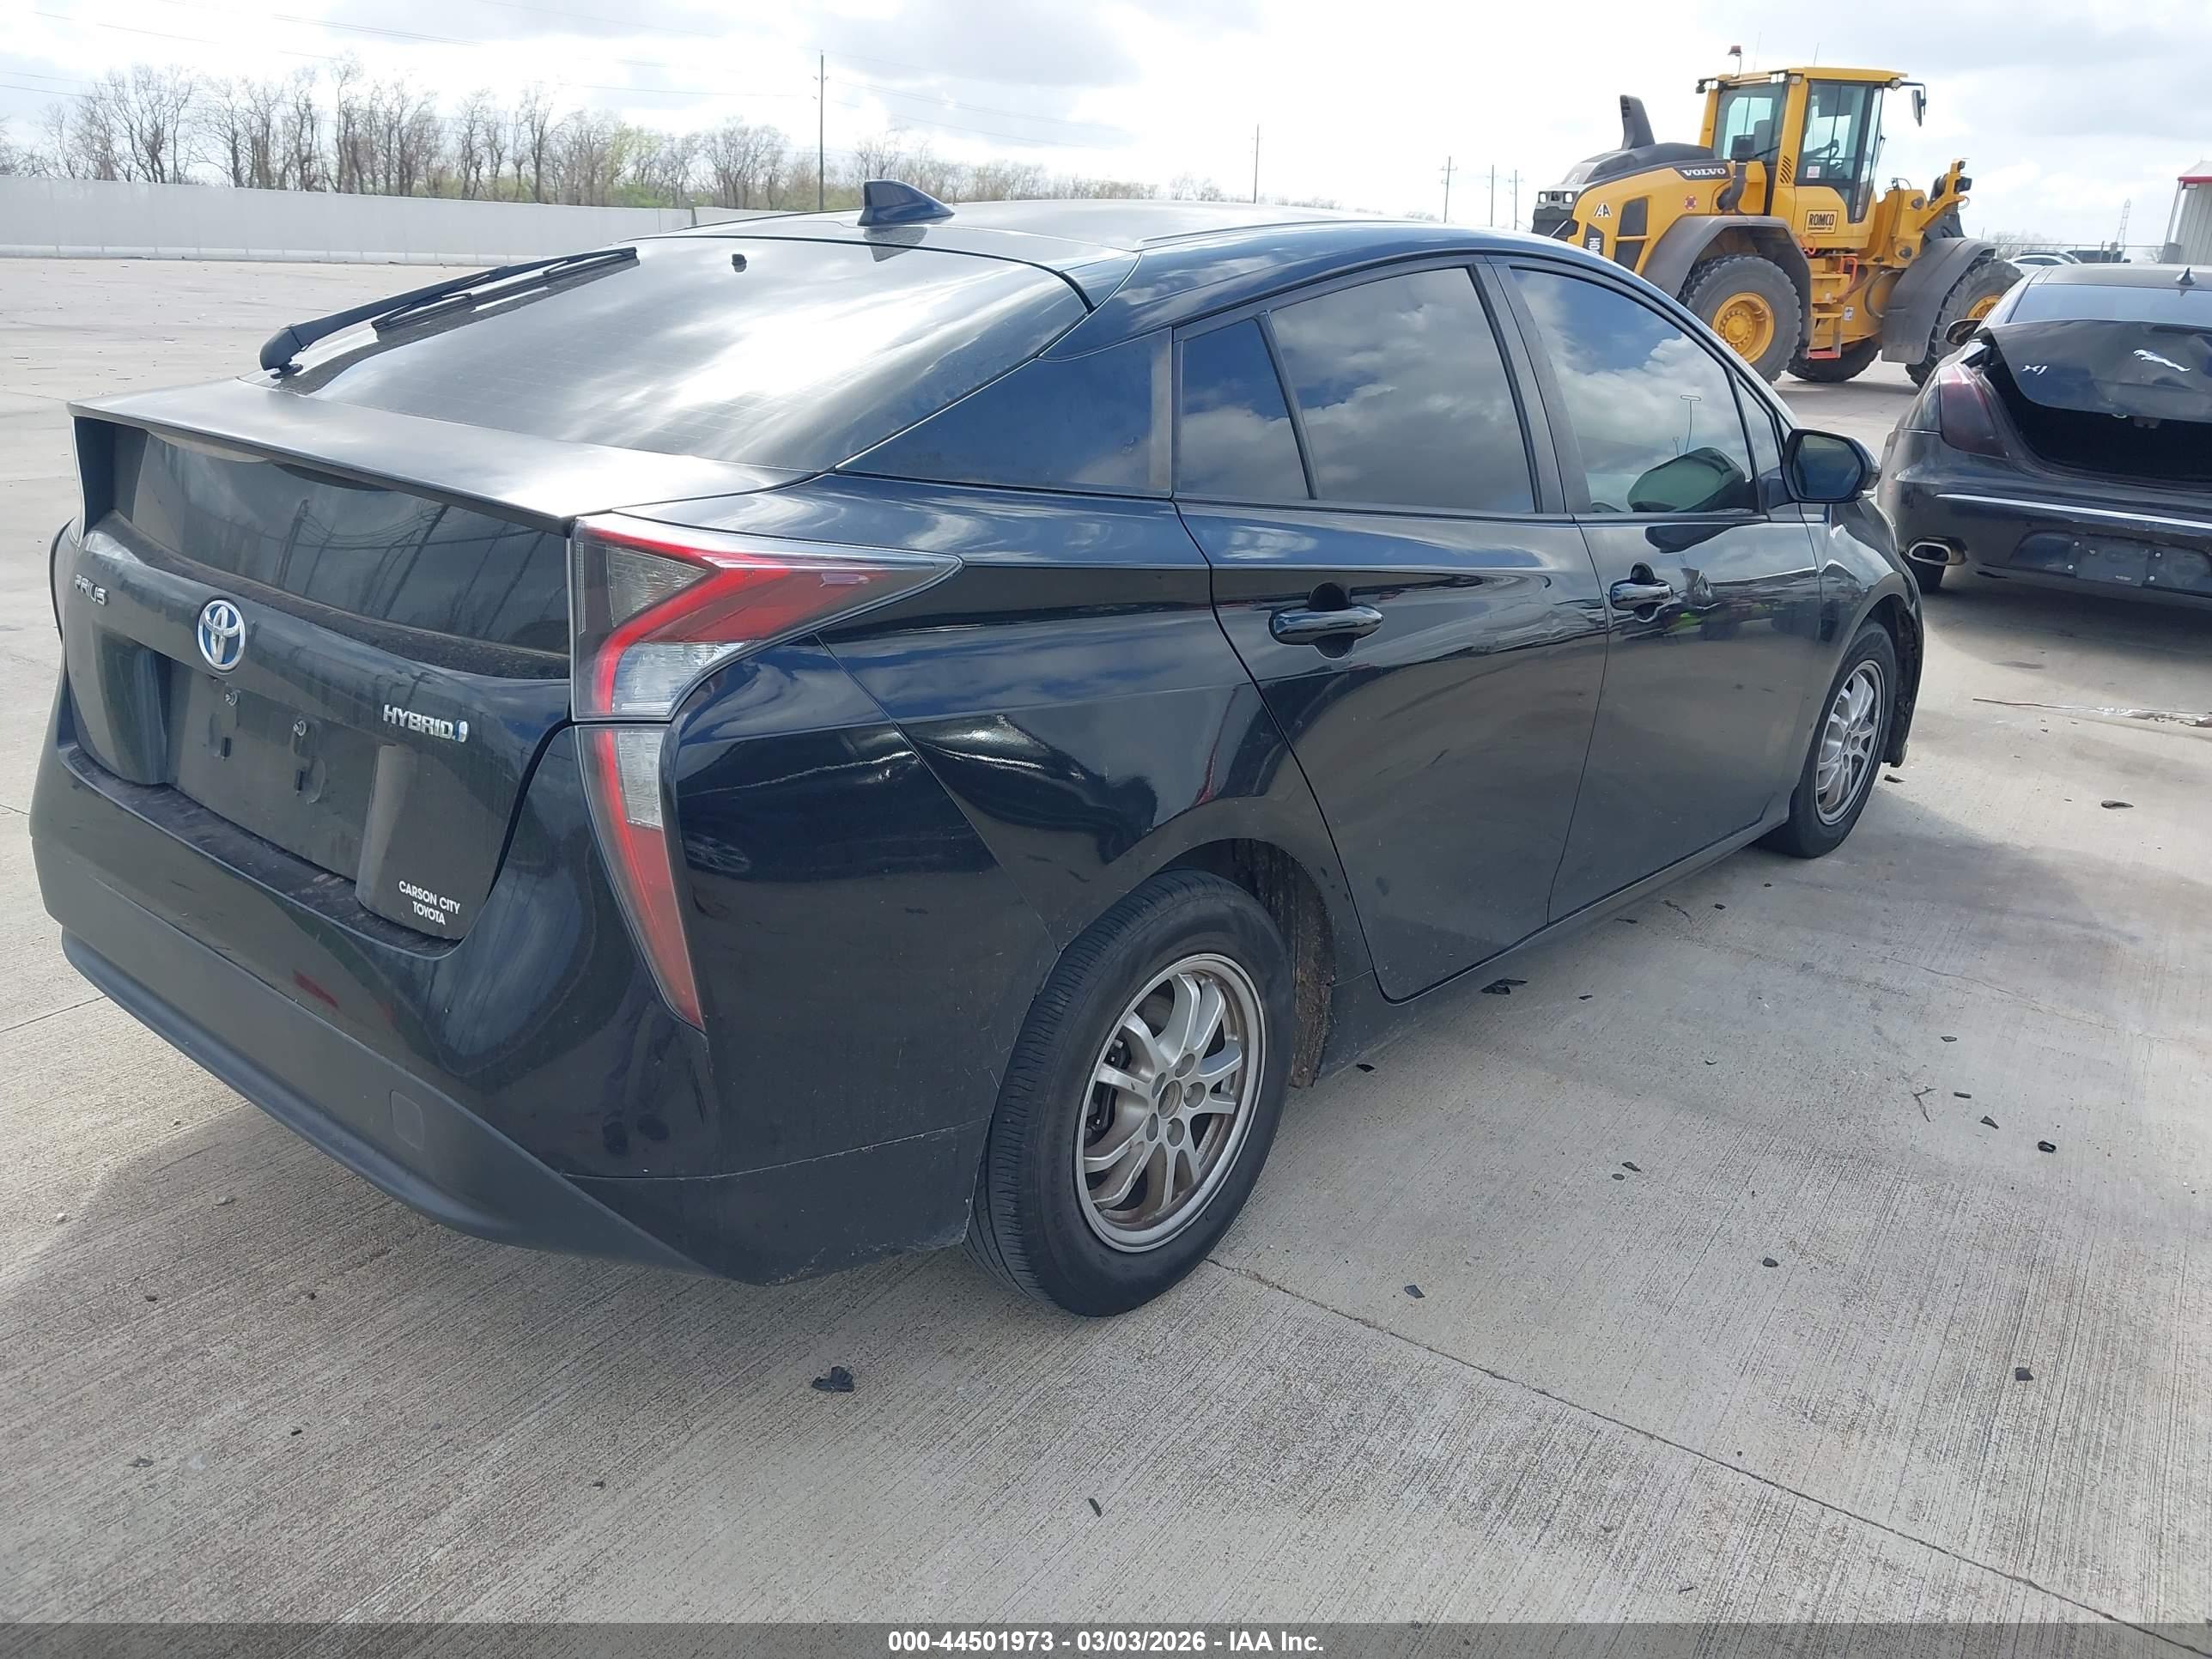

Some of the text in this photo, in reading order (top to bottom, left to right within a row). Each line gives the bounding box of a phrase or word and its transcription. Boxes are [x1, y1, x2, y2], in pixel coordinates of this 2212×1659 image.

[1681, 167, 1726, 176] VOLVO
[1808, 213, 1835, 226] ROMCO
[75, 574, 107, 606] PRIUS
[382, 704, 453, 739] HYBRID
[398, 880, 461, 915] CARSON CITY
[412, 901, 446, 926] TOYOTA
